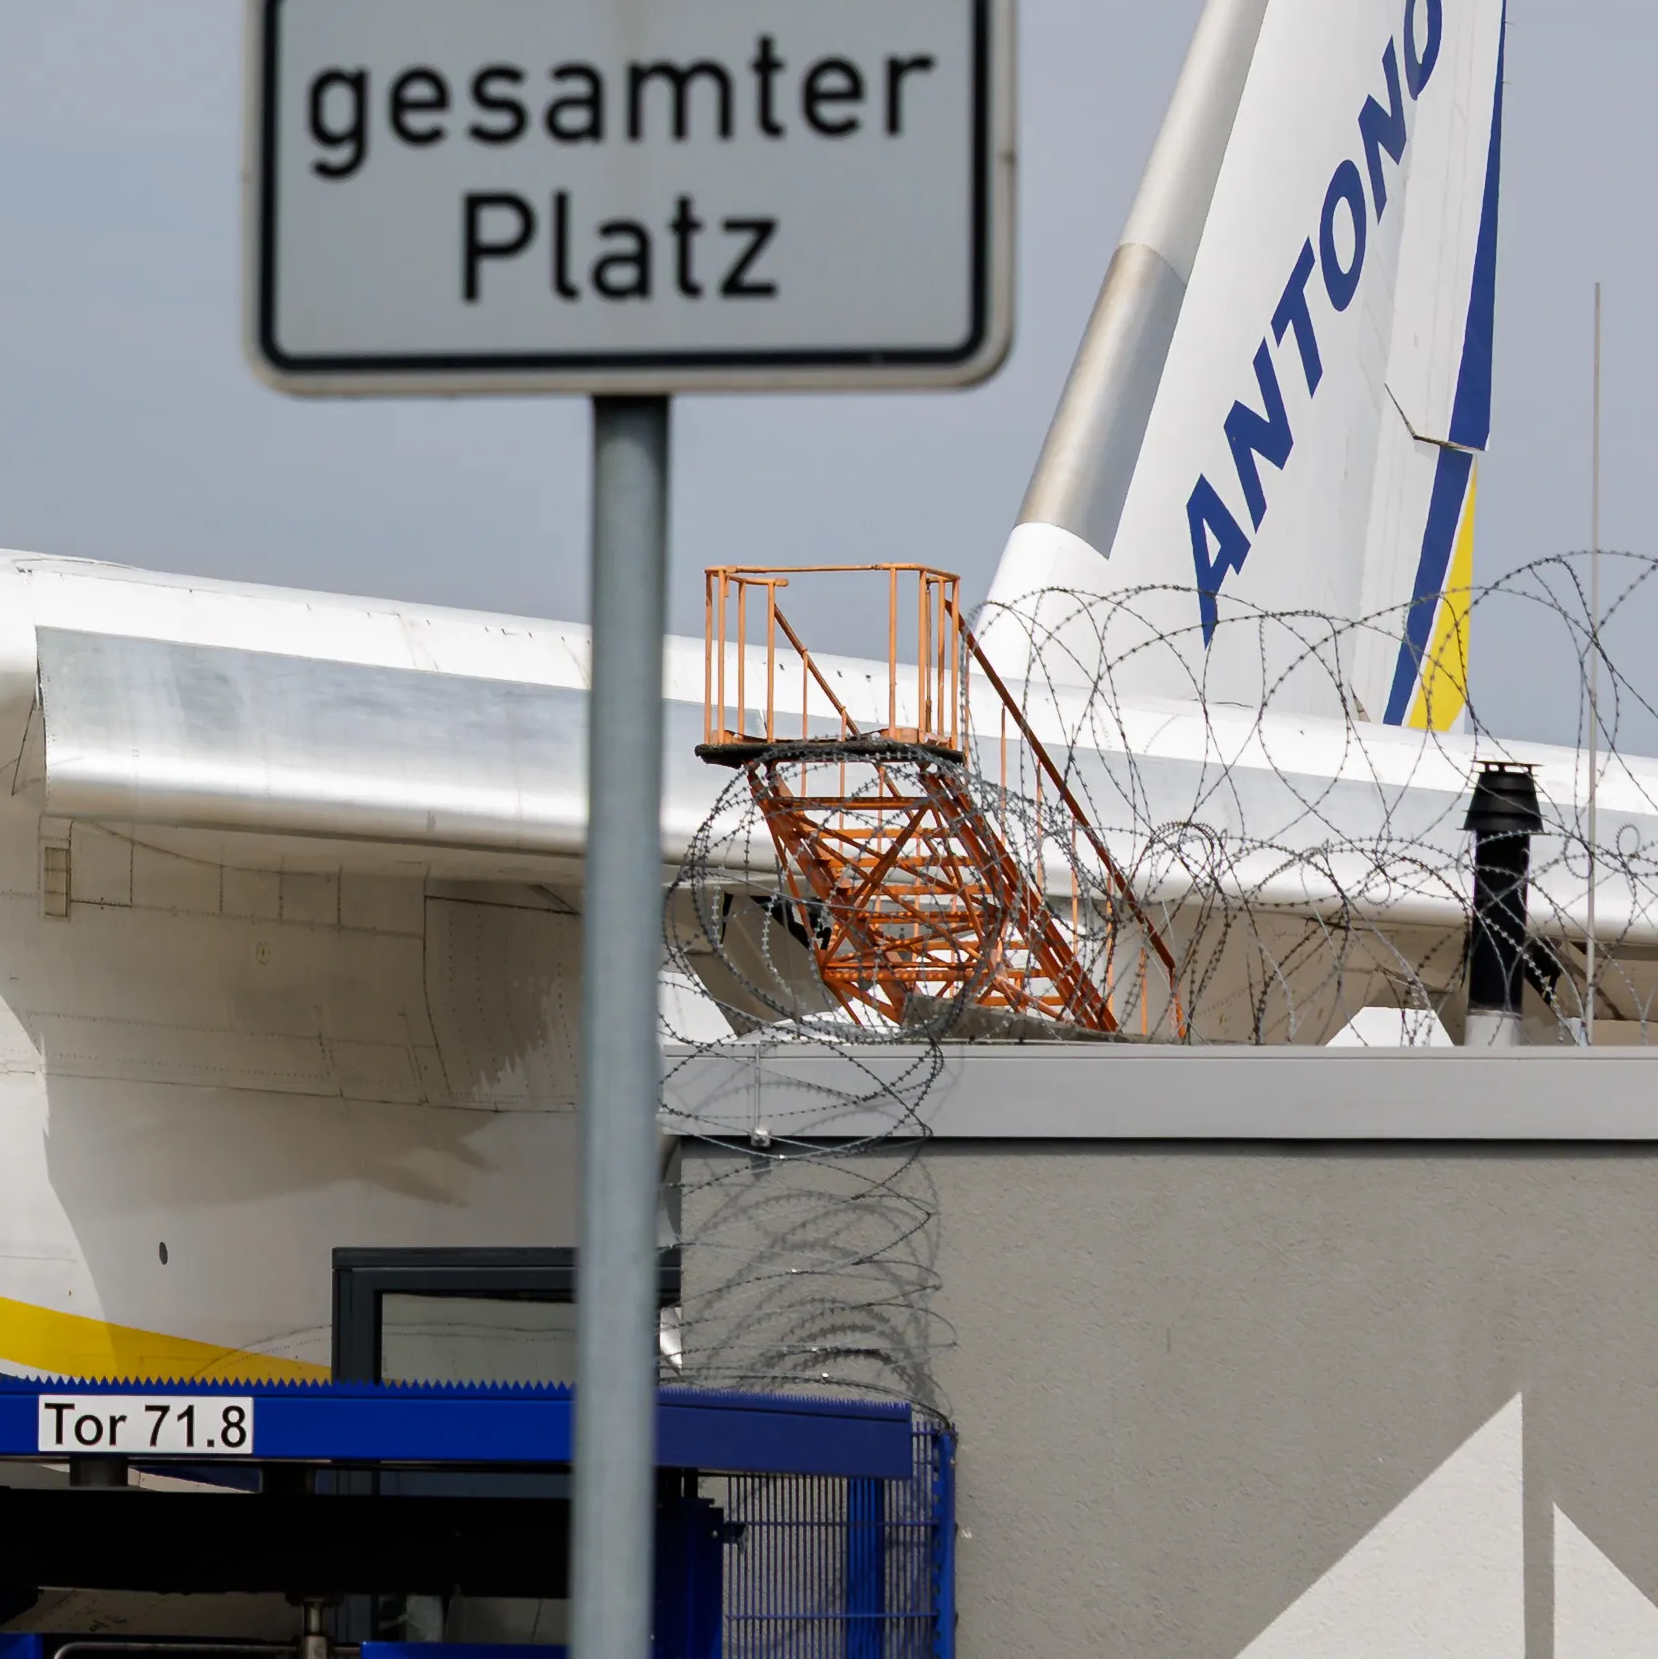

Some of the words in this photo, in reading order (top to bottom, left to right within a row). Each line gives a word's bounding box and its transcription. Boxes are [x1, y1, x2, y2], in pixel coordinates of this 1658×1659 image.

[307, 35, 936, 181] gesamter
[462, 190, 778, 304] Platz
[44, 1402, 128, 1446] Tor
[144, 1404, 247, 1449] 71.8
